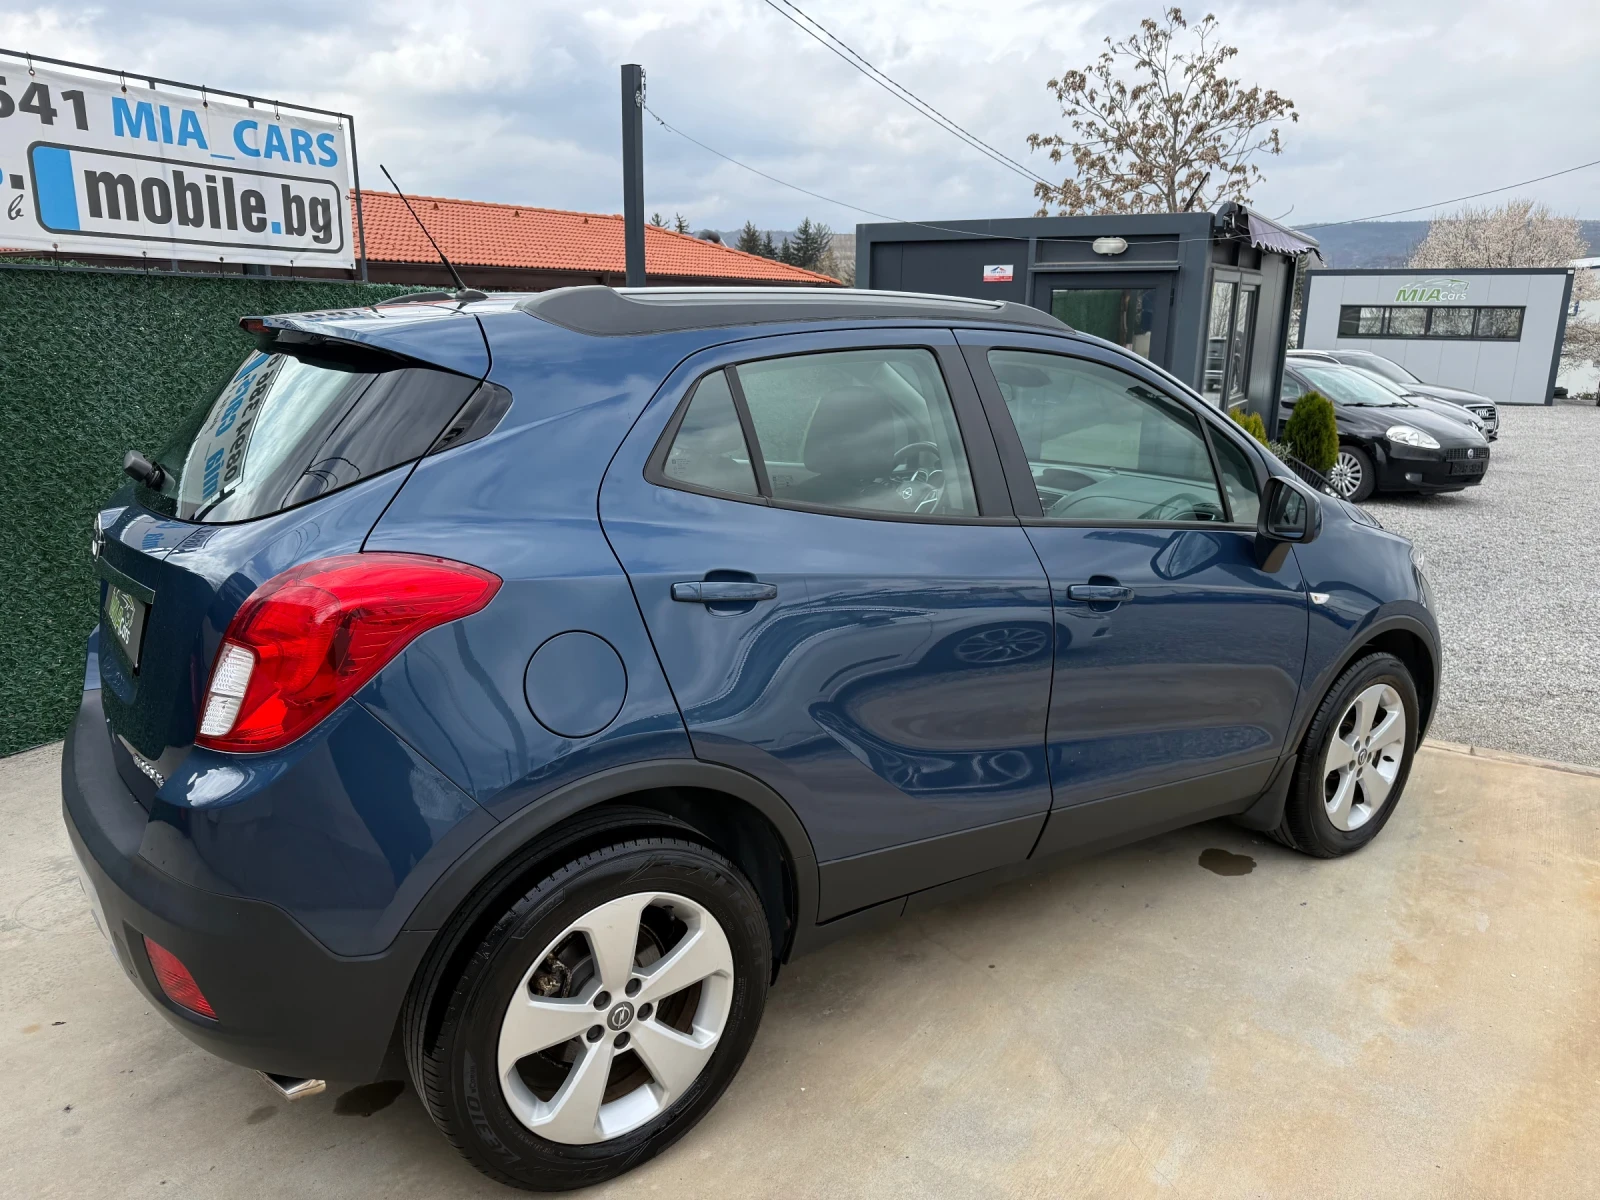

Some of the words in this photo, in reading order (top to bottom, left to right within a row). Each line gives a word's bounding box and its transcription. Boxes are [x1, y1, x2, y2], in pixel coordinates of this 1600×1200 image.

[111, 96, 338, 168] MIA_CARS
[83, 169, 333, 244] mobile.bg
[1395, 288, 1441, 302] MIA
